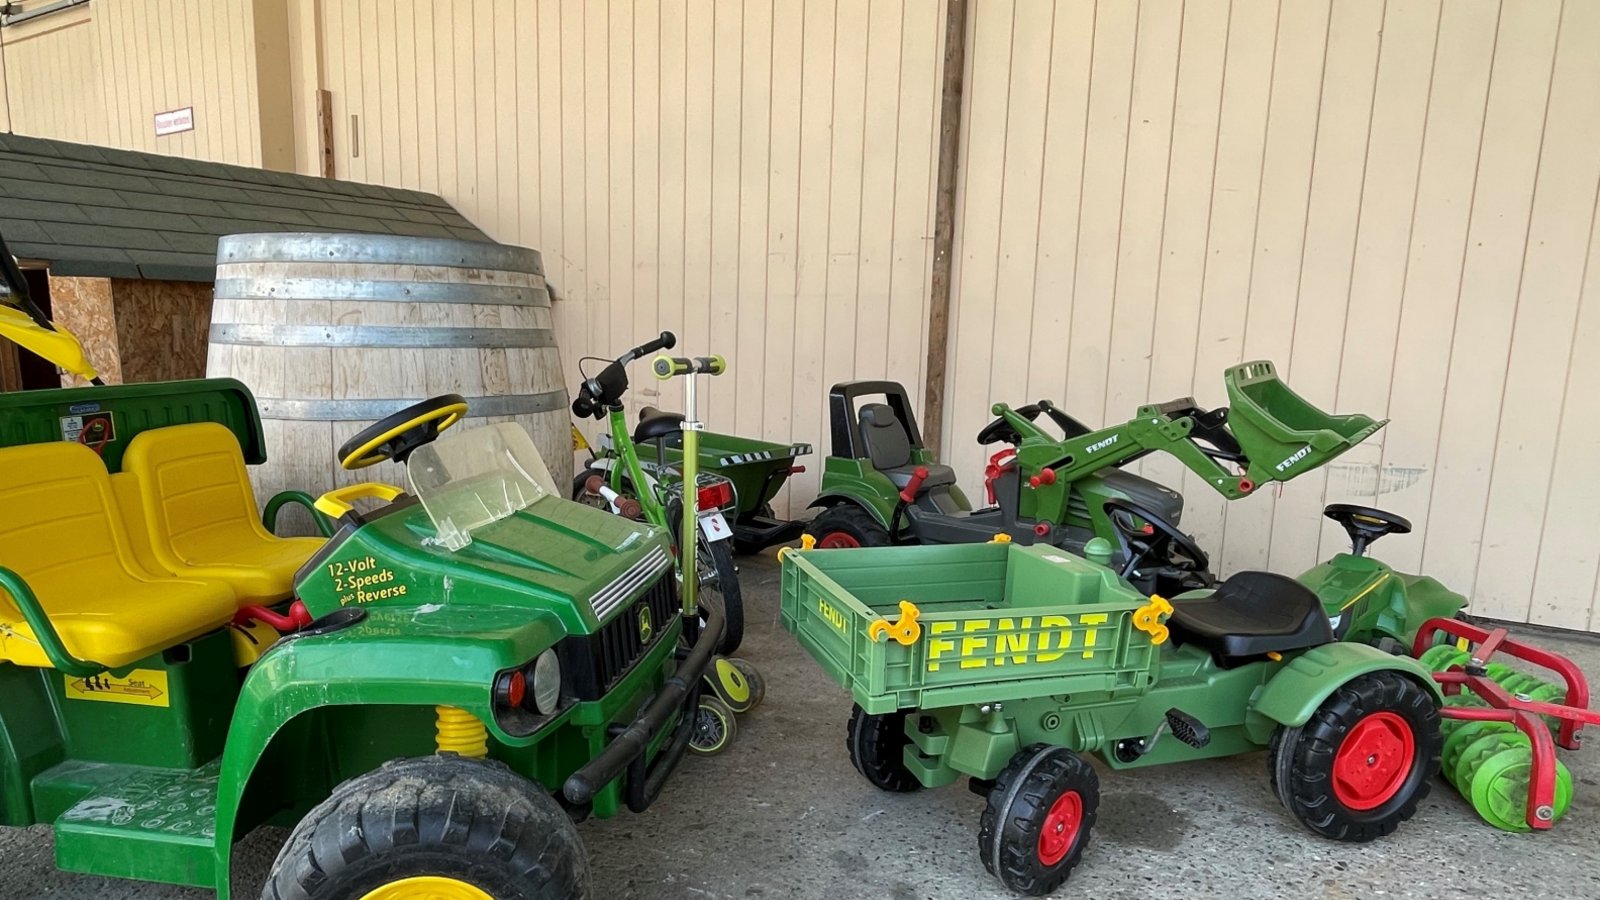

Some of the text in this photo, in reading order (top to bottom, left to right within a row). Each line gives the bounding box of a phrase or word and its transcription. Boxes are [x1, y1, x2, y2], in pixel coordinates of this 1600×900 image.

[1085, 433, 1119, 454] FENDT
[1275, 444, 1312, 472] FENDT
[328, 557, 376, 577] 12-Volt
[335, 568, 394, 592] 2-Speeds
[340, 585, 407, 607] plus Reverse
[819, 598, 848, 634] FENDT
[927, 612, 1109, 672] FENDT
